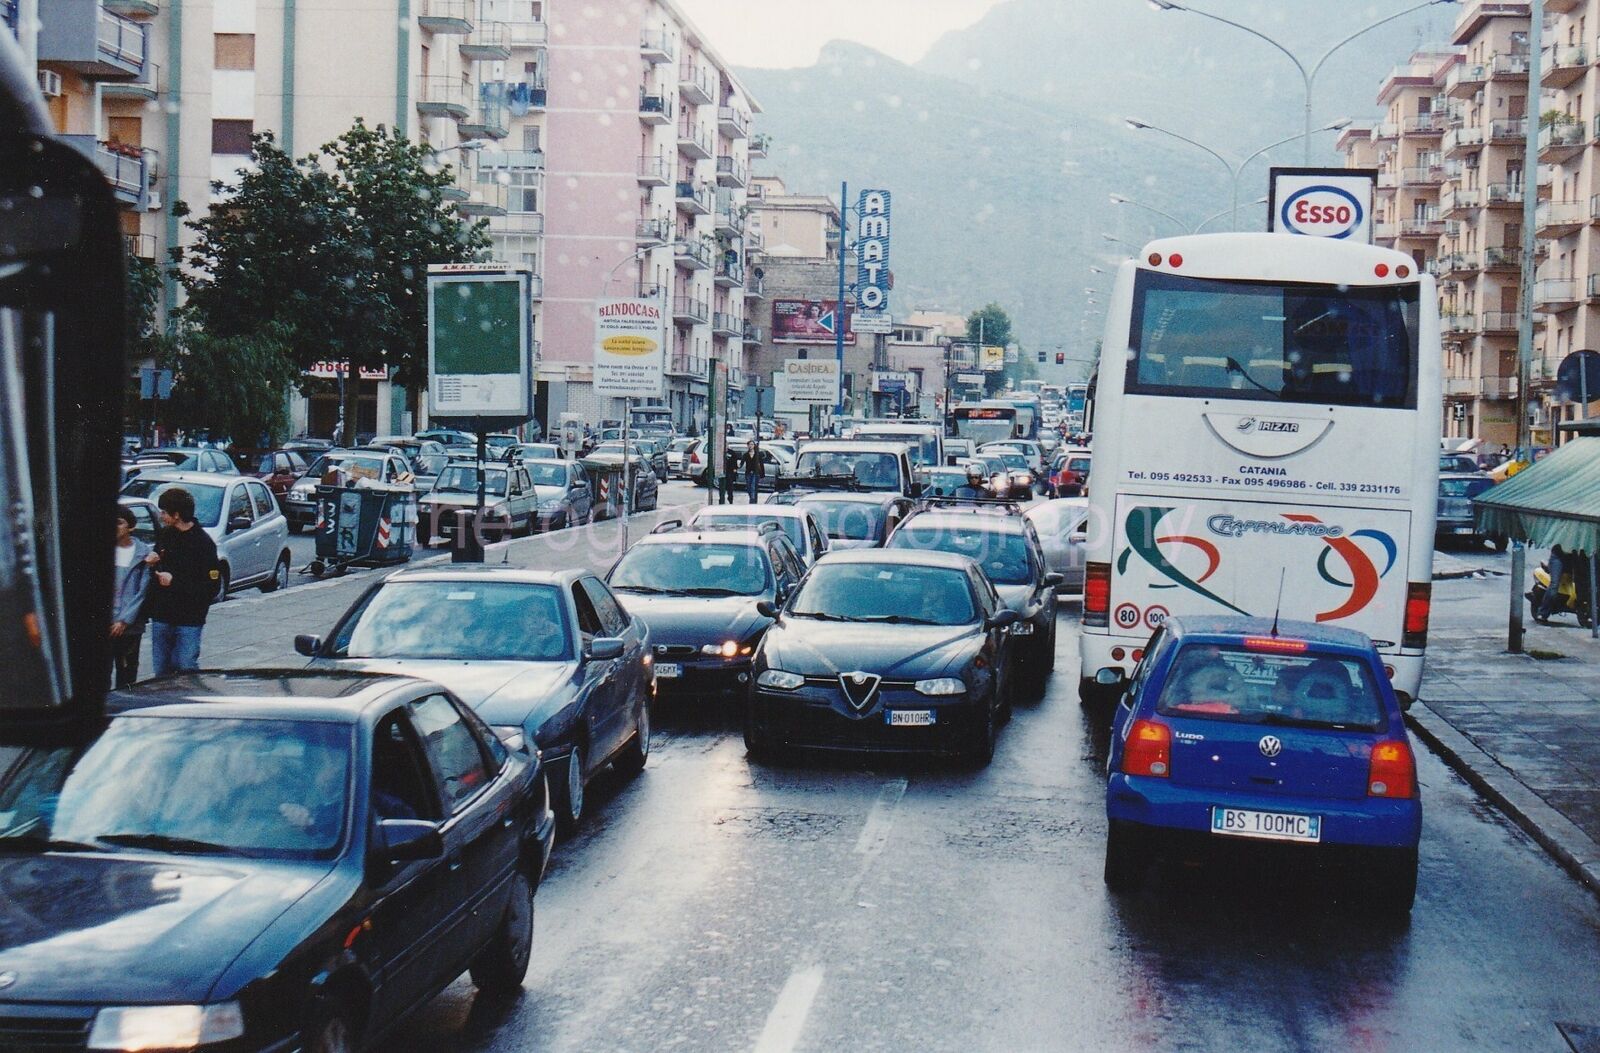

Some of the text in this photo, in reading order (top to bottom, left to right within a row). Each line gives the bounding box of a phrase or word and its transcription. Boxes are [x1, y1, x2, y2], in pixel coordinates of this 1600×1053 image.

[860, 191, 889, 308] AMATO
[599, 303, 661, 319] BLINDOCASA
[1258, 421, 1299, 432] IRIZAR
[1239, 466, 1287, 476] CATANIA
[1128, 471, 1147, 479] Tel.
[1150, 472, 1169, 480] 095
[1173, 474, 1212, 483] 492533
[1222, 476, 1241, 485] Fax
[1244, 477, 1264, 486] 095
[1267, 479, 1306, 489] 496986
[1316, 481, 1337, 491] Cell.
[1340, 483, 1357, 492] 339
[1360, 484, 1401, 494] 2331176
[1120, 610, 1135, 622] 80
[1150, 613, 1165, 623] 100
[893, 713, 930, 723] BN 010HR
[1226, 811, 1306, 834] BS 100MC
